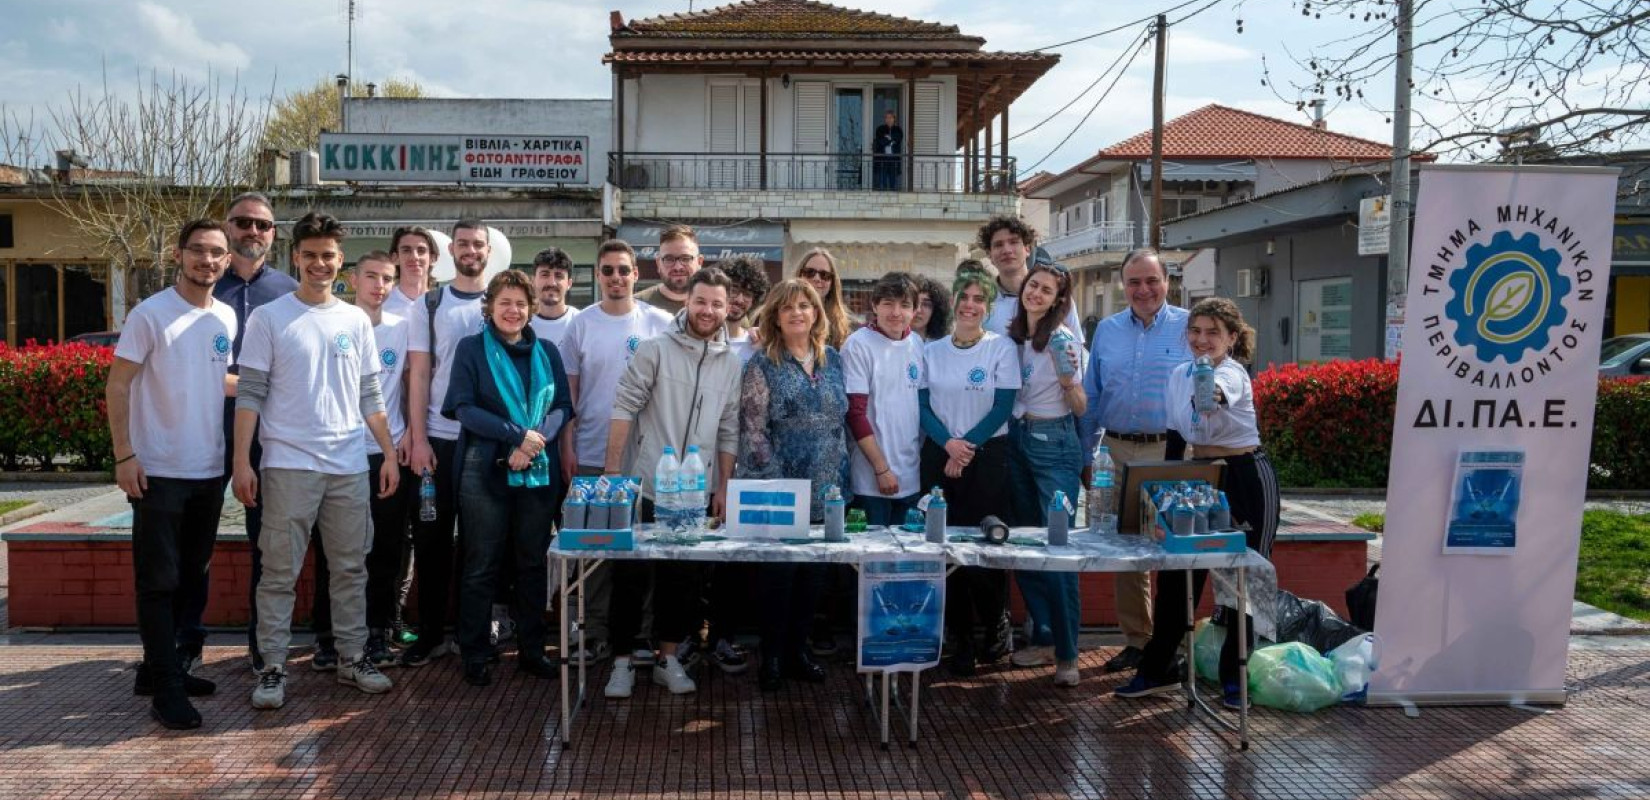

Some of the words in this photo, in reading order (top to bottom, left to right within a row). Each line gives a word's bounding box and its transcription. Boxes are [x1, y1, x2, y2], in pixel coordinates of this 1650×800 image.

[325, 143, 460, 171] ΚΟΚΚΙΝΗΣ
[465, 139, 511, 150] ΒΙΒΛΙΑ
[523, 140, 583, 151] ΧΑΡΤΙΚΑ
[465, 153, 582, 165] ΦΩΤΟΑΝΤΙΓΡΑΦΑ
[470, 167, 503, 178] ΕΙΔΗ
[511, 168, 578, 179] ΓΡΑΦΕΙΟΥ
[1423, 219, 1481, 296] ΤΜΗΜΑ
[1497, 205, 1594, 301] ΜΗΧΑΝΙΚΩΝ
[1423, 315, 1587, 389] ΠΕΡΙΒΑΛΛΟΝΤΟΣ
[1413, 400, 1577, 428] ΔΙ.ΠΑ.Ε.
